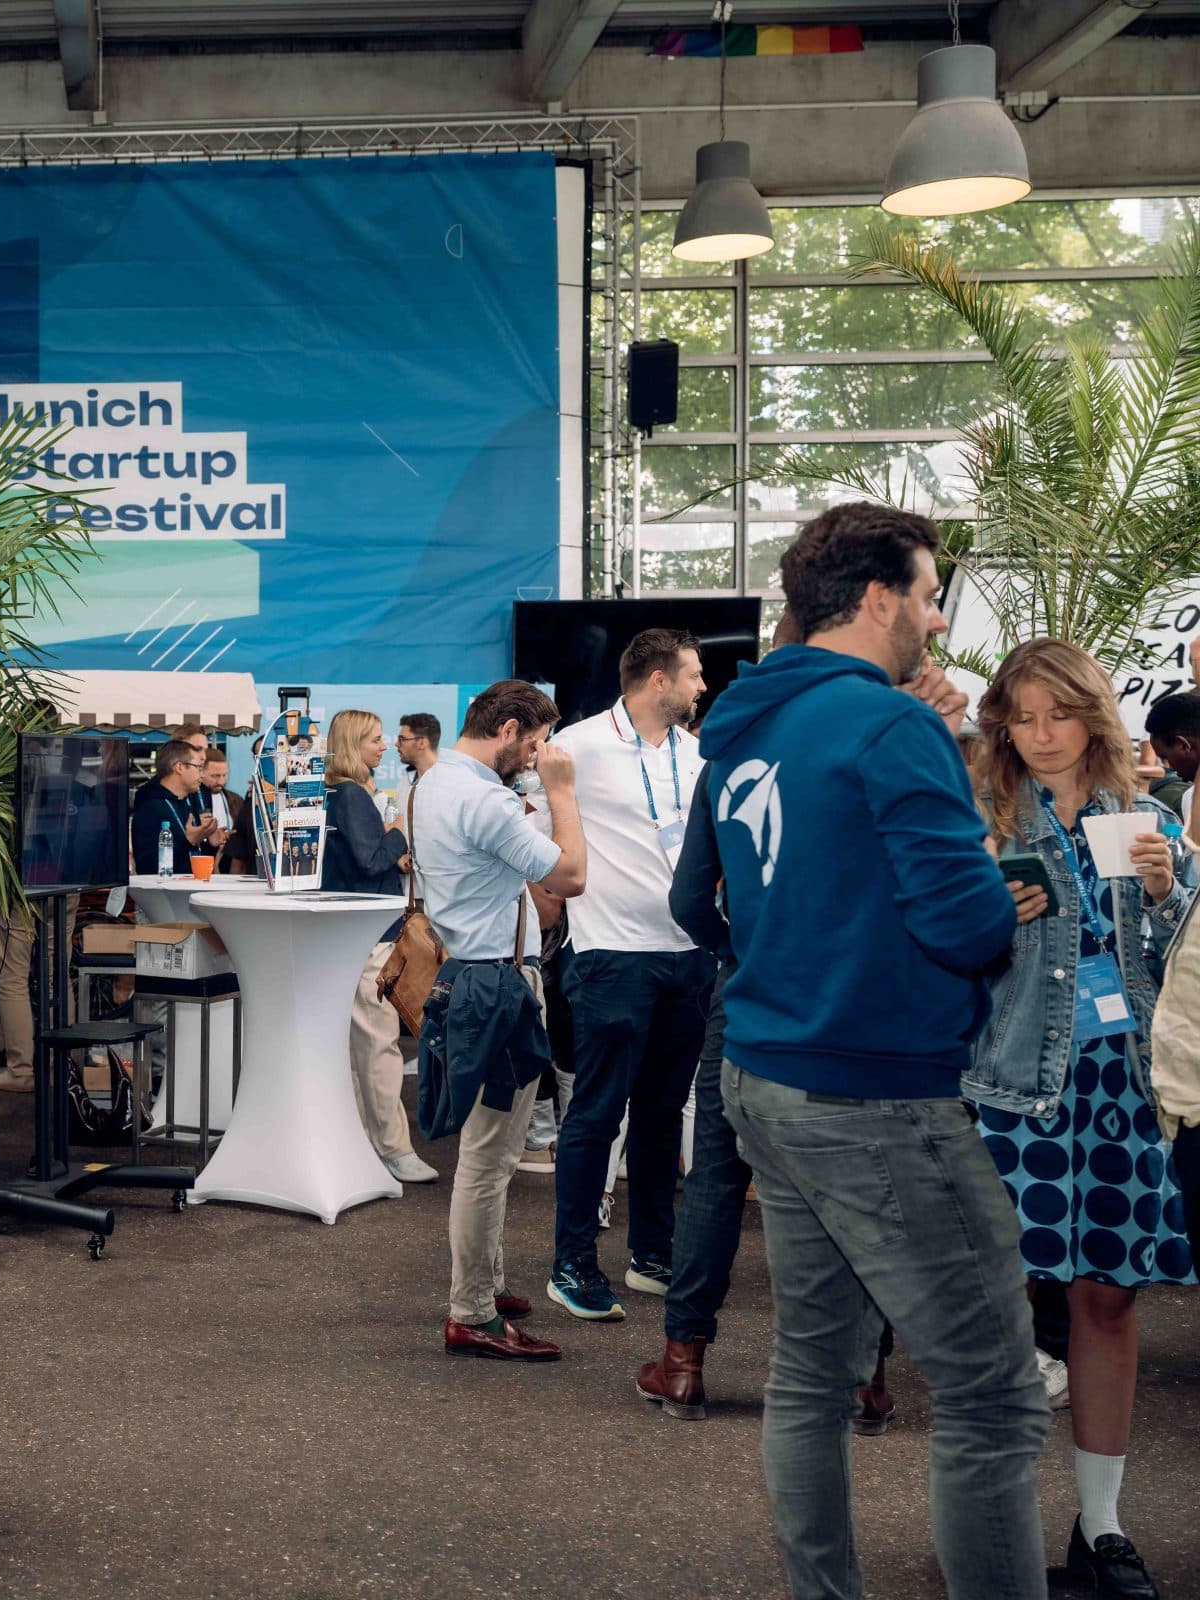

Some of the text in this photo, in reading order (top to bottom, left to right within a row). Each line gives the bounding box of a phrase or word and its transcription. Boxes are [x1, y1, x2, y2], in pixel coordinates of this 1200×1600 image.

[3, 444, 237, 484] Startup
[47, 492, 282, 533] Festival
[1119, 677, 1198, 706] PIZ
